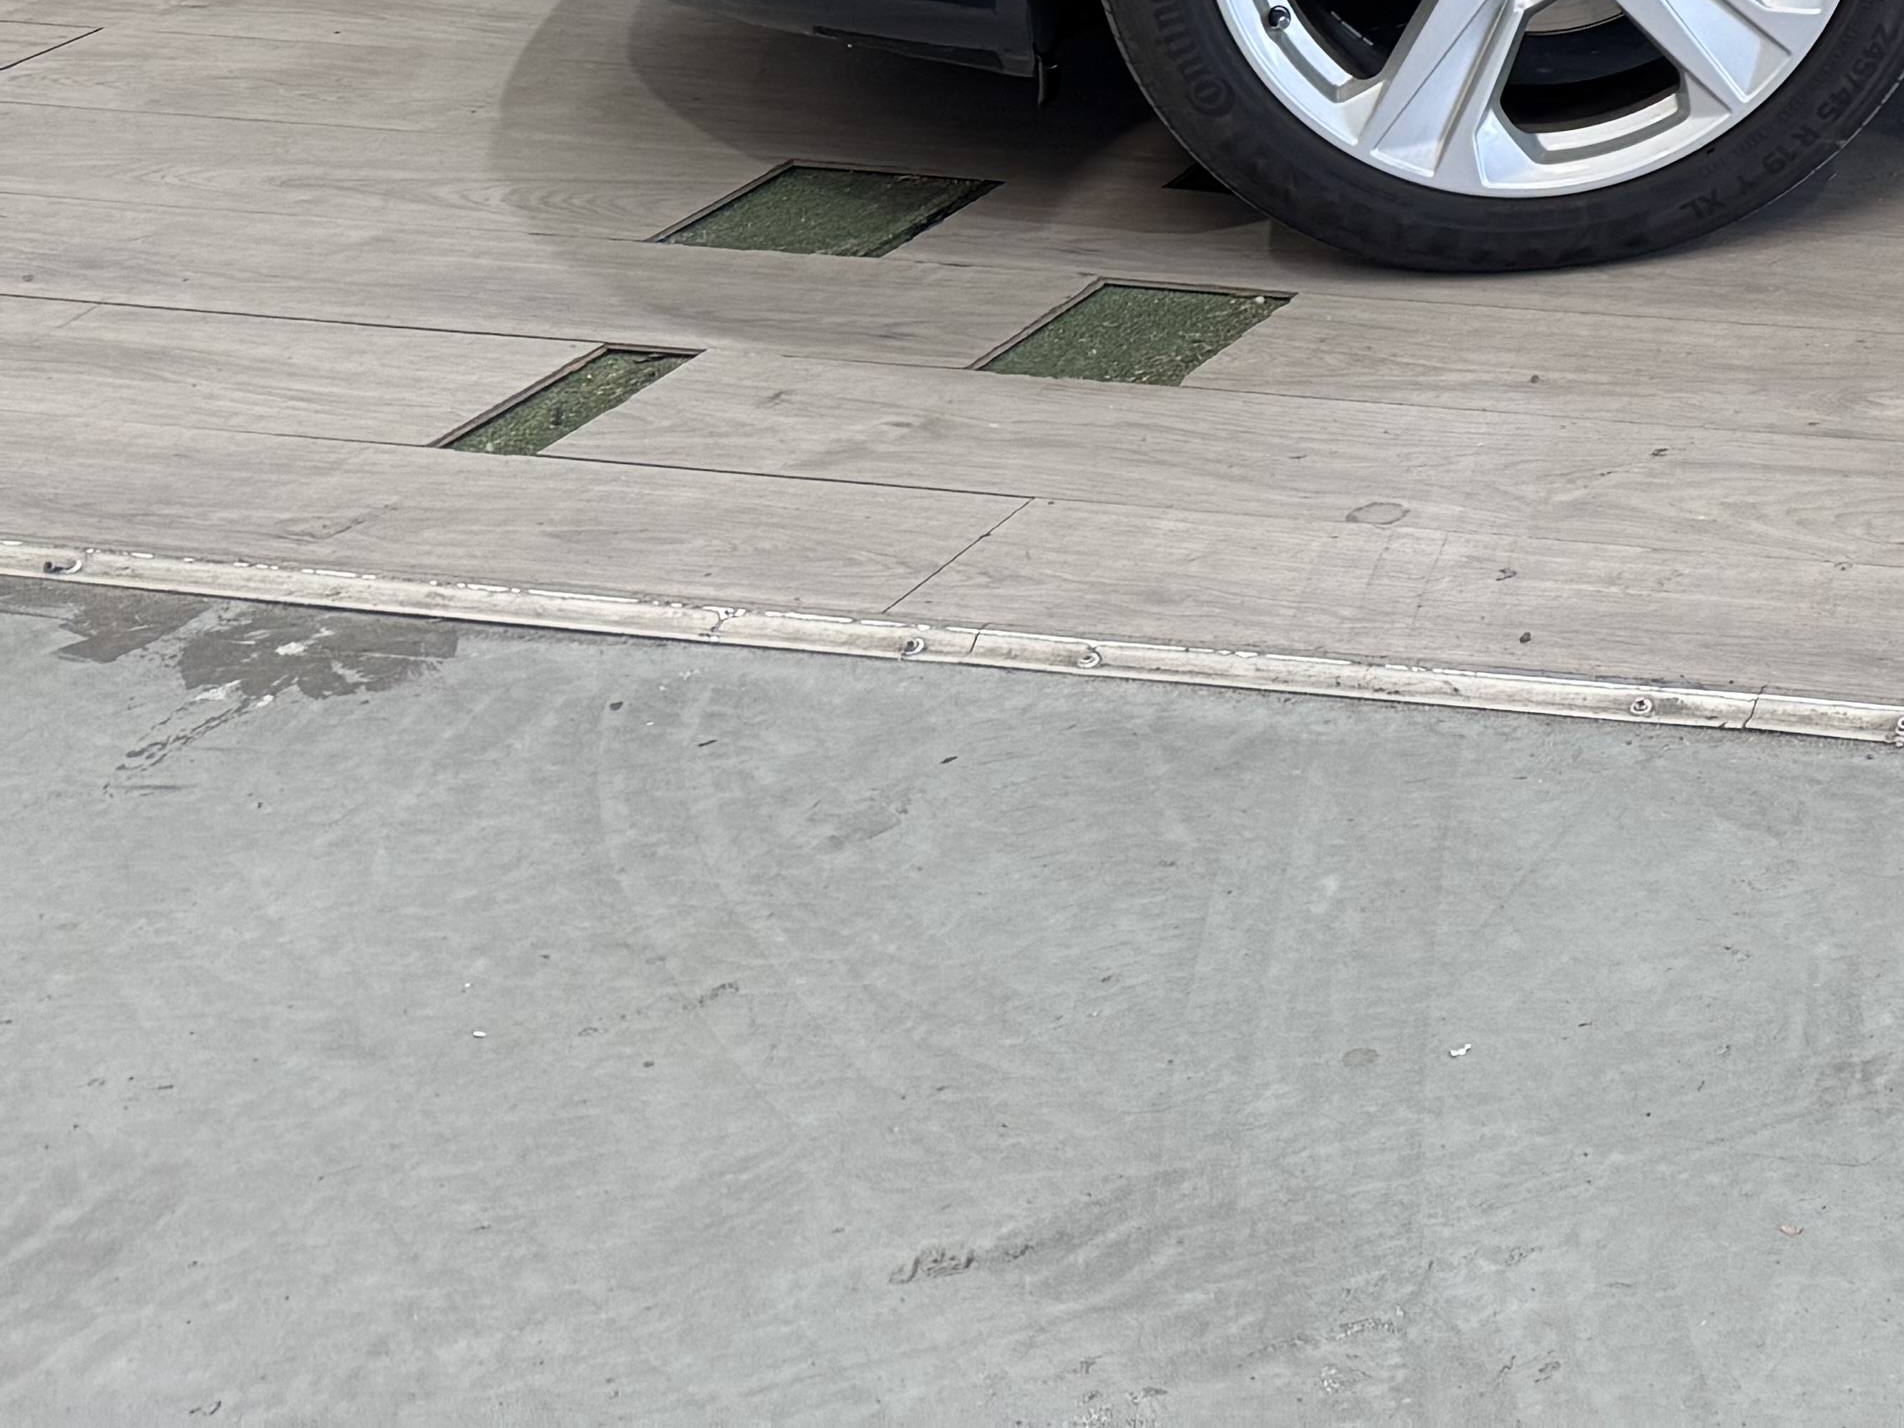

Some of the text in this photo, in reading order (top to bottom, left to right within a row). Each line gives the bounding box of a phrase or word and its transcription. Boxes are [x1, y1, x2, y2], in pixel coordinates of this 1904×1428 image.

[1815, 22, 1897, 124] 245/45
[1789, 120, 1821, 149] R
[1761, 143, 1797, 176] 19
